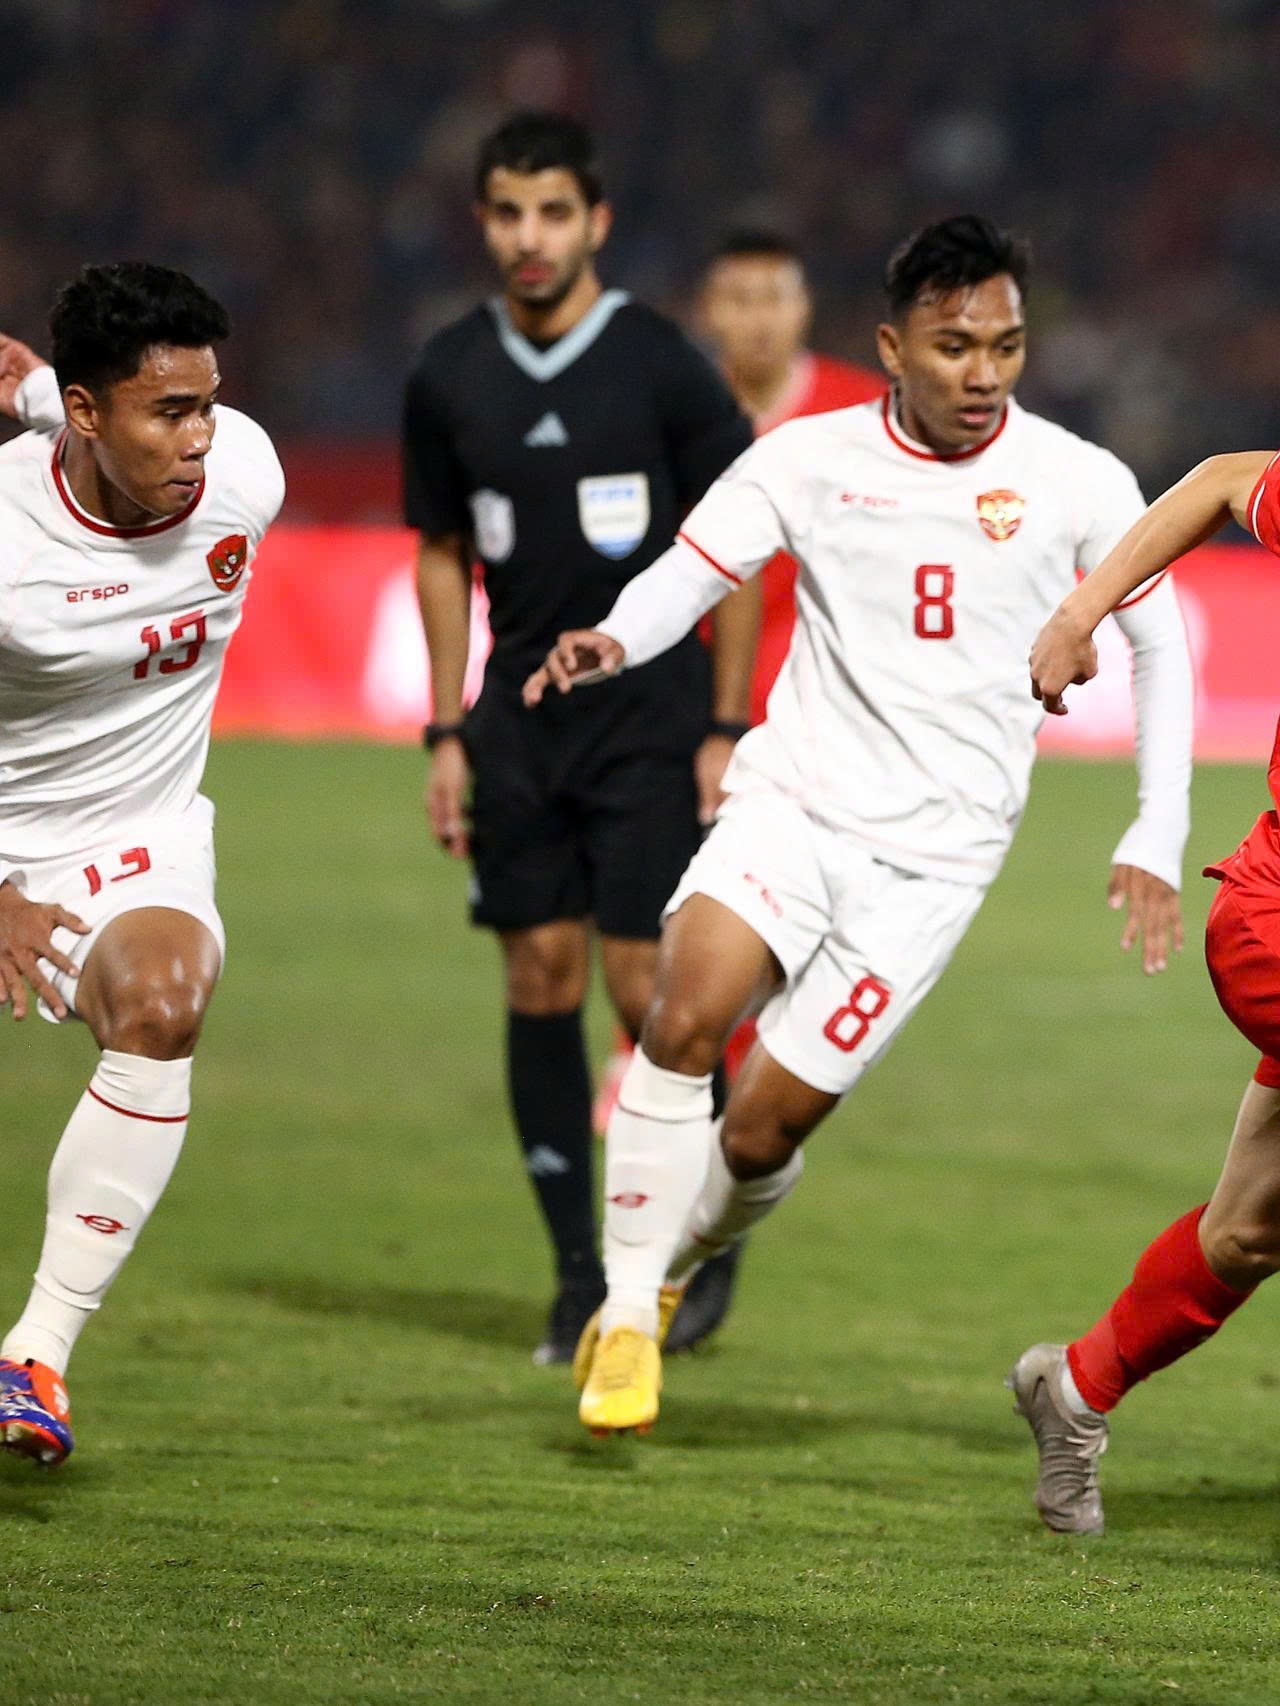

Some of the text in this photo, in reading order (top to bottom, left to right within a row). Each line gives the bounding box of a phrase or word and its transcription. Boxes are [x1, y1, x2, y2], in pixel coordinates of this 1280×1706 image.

[66, 583, 129, 603] erspo
[914, 563, 954, 639] 8
[133, 608, 207, 680] 13
[823, 974, 891, 1054] 8
